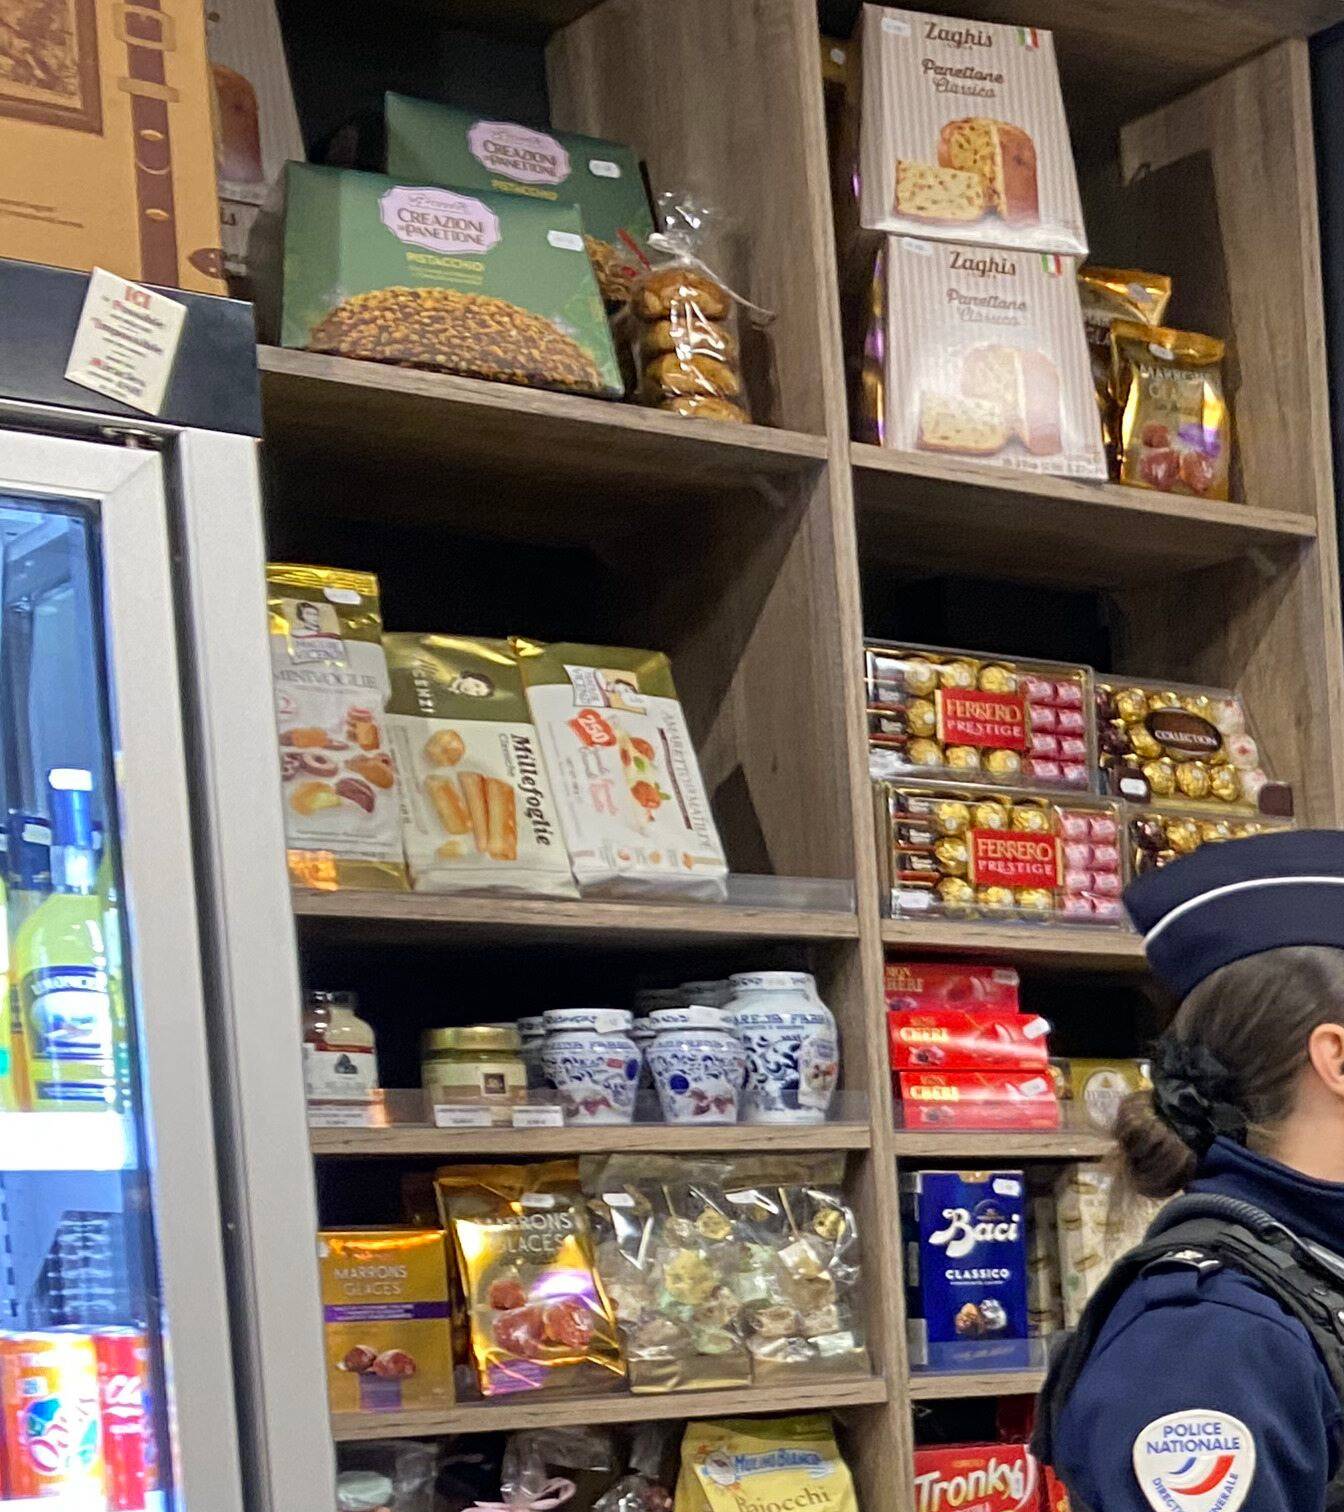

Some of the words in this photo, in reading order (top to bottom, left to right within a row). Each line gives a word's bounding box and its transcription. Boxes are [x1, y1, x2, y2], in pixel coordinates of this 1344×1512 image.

[925, 21, 992, 48] Zaghis
[922, 58, 1004, 84] Panettone
[397, 207, 484, 233] CREAZIONI
[406, 224, 484, 245] PANETTONE
[950, 250, 1016, 277] Zaghis
[946, 699, 1022, 726] FERRERO
[946, 718, 1022, 739] PRESTIGE
[1154, 728, 1218, 747] COLLECTION
[510, 733, 554, 847] Millefoglie
[977, 837, 1053, 862] FERRERO
[977, 855, 1054, 877] PRESTIGE
[929, 1207, 1020, 1258] Baci
[945, 1268, 1010, 1281] CLASSICO
[1163, 1422, 1222, 1438] POLICE
[1147, 1437, 1240, 1454] NATIONALE
